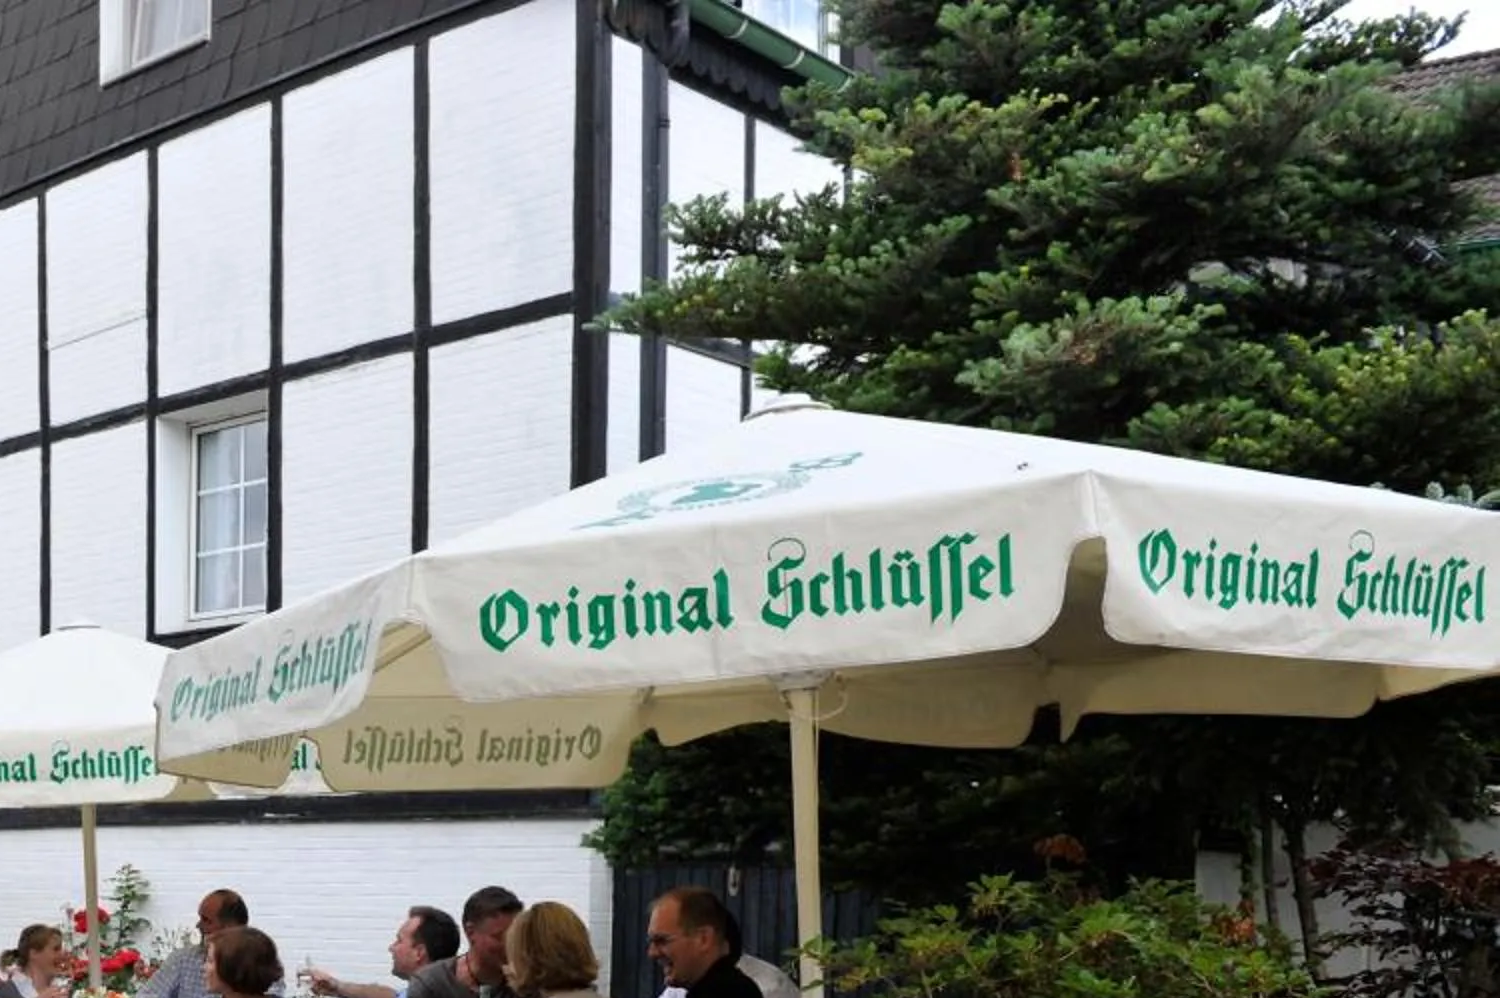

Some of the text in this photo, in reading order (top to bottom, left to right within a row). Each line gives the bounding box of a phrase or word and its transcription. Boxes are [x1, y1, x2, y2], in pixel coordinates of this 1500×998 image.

[479, 567, 734, 653] Original
[1137, 527, 1320, 610] Original
[170, 656, 262, 722] Original
